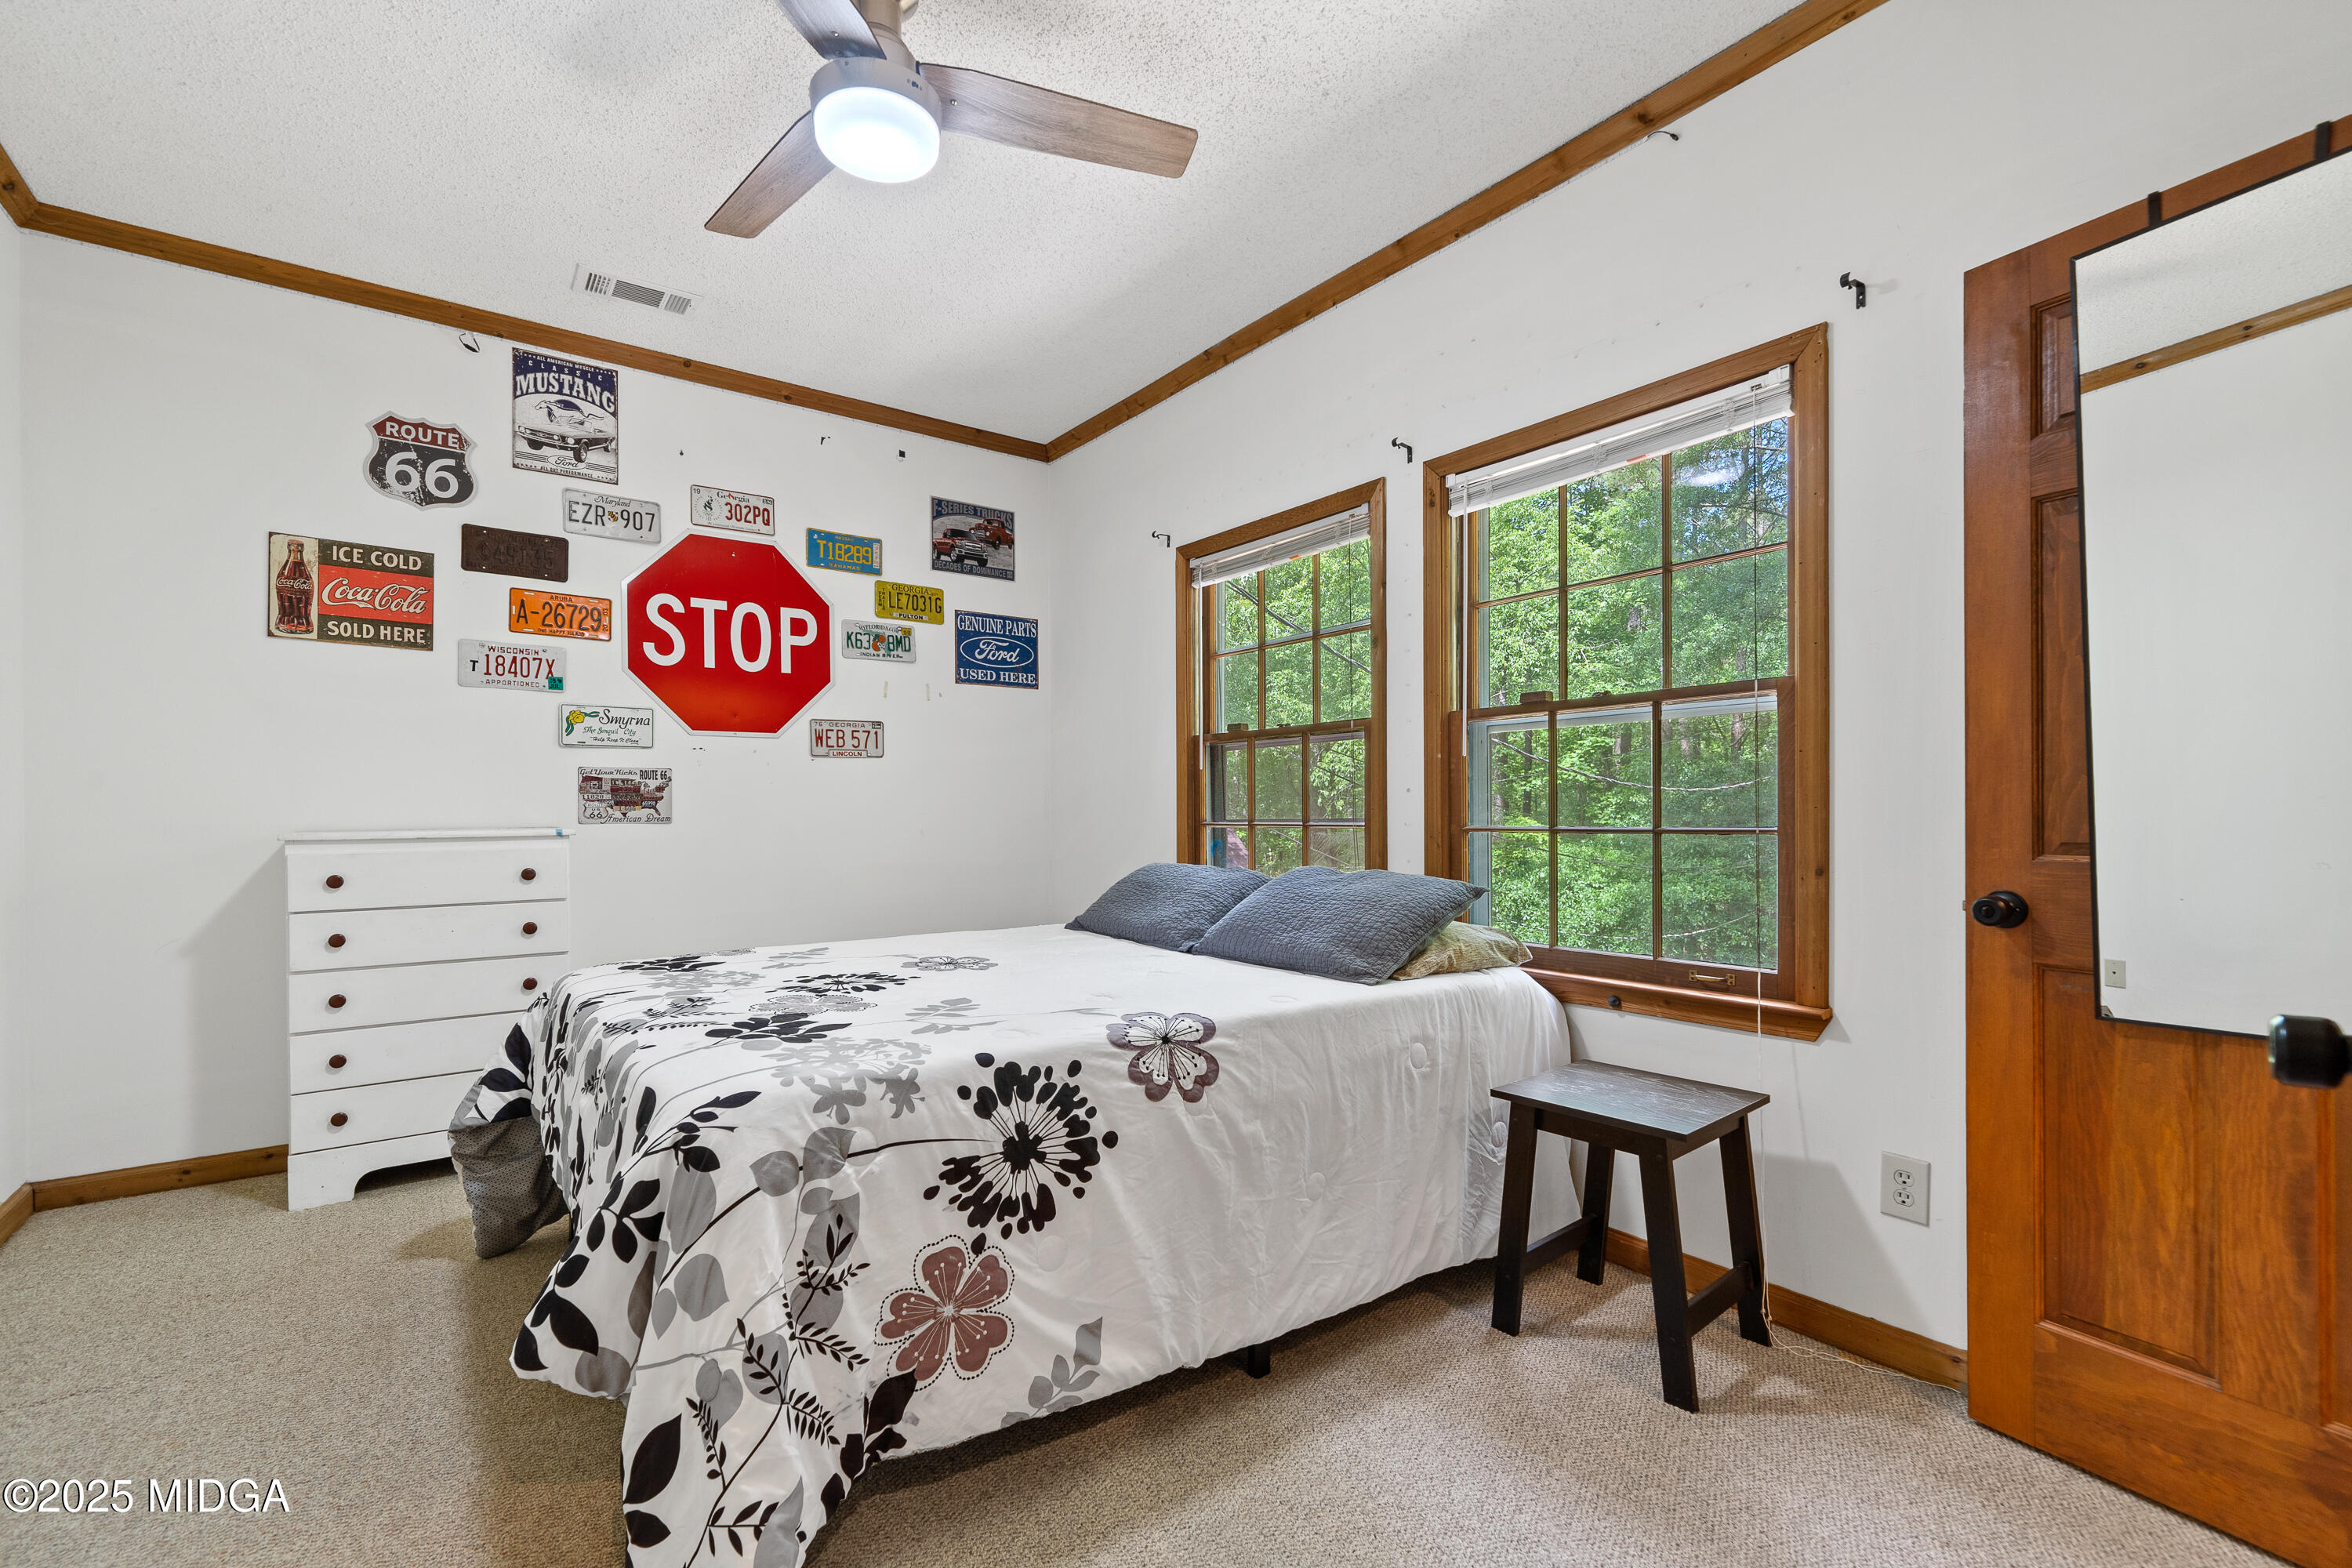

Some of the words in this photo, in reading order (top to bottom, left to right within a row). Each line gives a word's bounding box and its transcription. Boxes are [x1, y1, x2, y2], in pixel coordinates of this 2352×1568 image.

[528, 361, 602, 381] CLASSIC
[547, 358, 573, 368] AMERICAN
[575, 362, 594, 372] MUSCLE
[516, 372, 615, 413] MUSTANG
[386, 421, 459, 448] ROUTE
[554, 456, 579, 468] Ford
[386, 452, 459, 499] 66
[560, 469, 593, 478] PERFORMANCE
[594, 495, 631, 507] Maryland
[933, 499, 975, 517] F-SERIES
[569, 500, 605, 526] EZR
[620, 509, 655, 532] 907
[724, 502, 770, 526] 302PQ
[332, 545, 364, 564] ICE
[370, 551, 422, 571] COLD
[817, 539, 872, 564] T18289
[829, 562, 860, 571] BAHAMAS
[934, 561, 961, 571] DECADES
[972, 565, 1007, 578] DOMINANCE
[888, 591, 942, 614] LE7031G
[517, 598, 601, 631] A-26729
[327, 620, 375, 639] SOLD
[379, 625, 426, 644] HERE
[642, 593, 818, 674] STOP
[957, 615, 1004, 634] GENUINE
[1005, 619, 1036, 638] PARTS
[488, 645, 539, 655] WISCONSIN
[847, 631, 871, 650] K63
[975, 639, 1020, 662] Ford
[470, 659, 478, 672] T
[484, 654, 555, 679] 18407X
[960, 668, 996, 681] USED
[999, 671, 1036, 684] HERE
[485, 679, 540, 688] APPORTIONED
[598, 708, 651, 729] Smyrna
[815, 728, 845, 748] WEB
[851, 730, 878, 749] 571
[639, 769, 658, 780] ROUTE
[660, 770, 668, 780] 66
[601, 813, 642, 824] American
[644, 813, 671, 822] Dream
